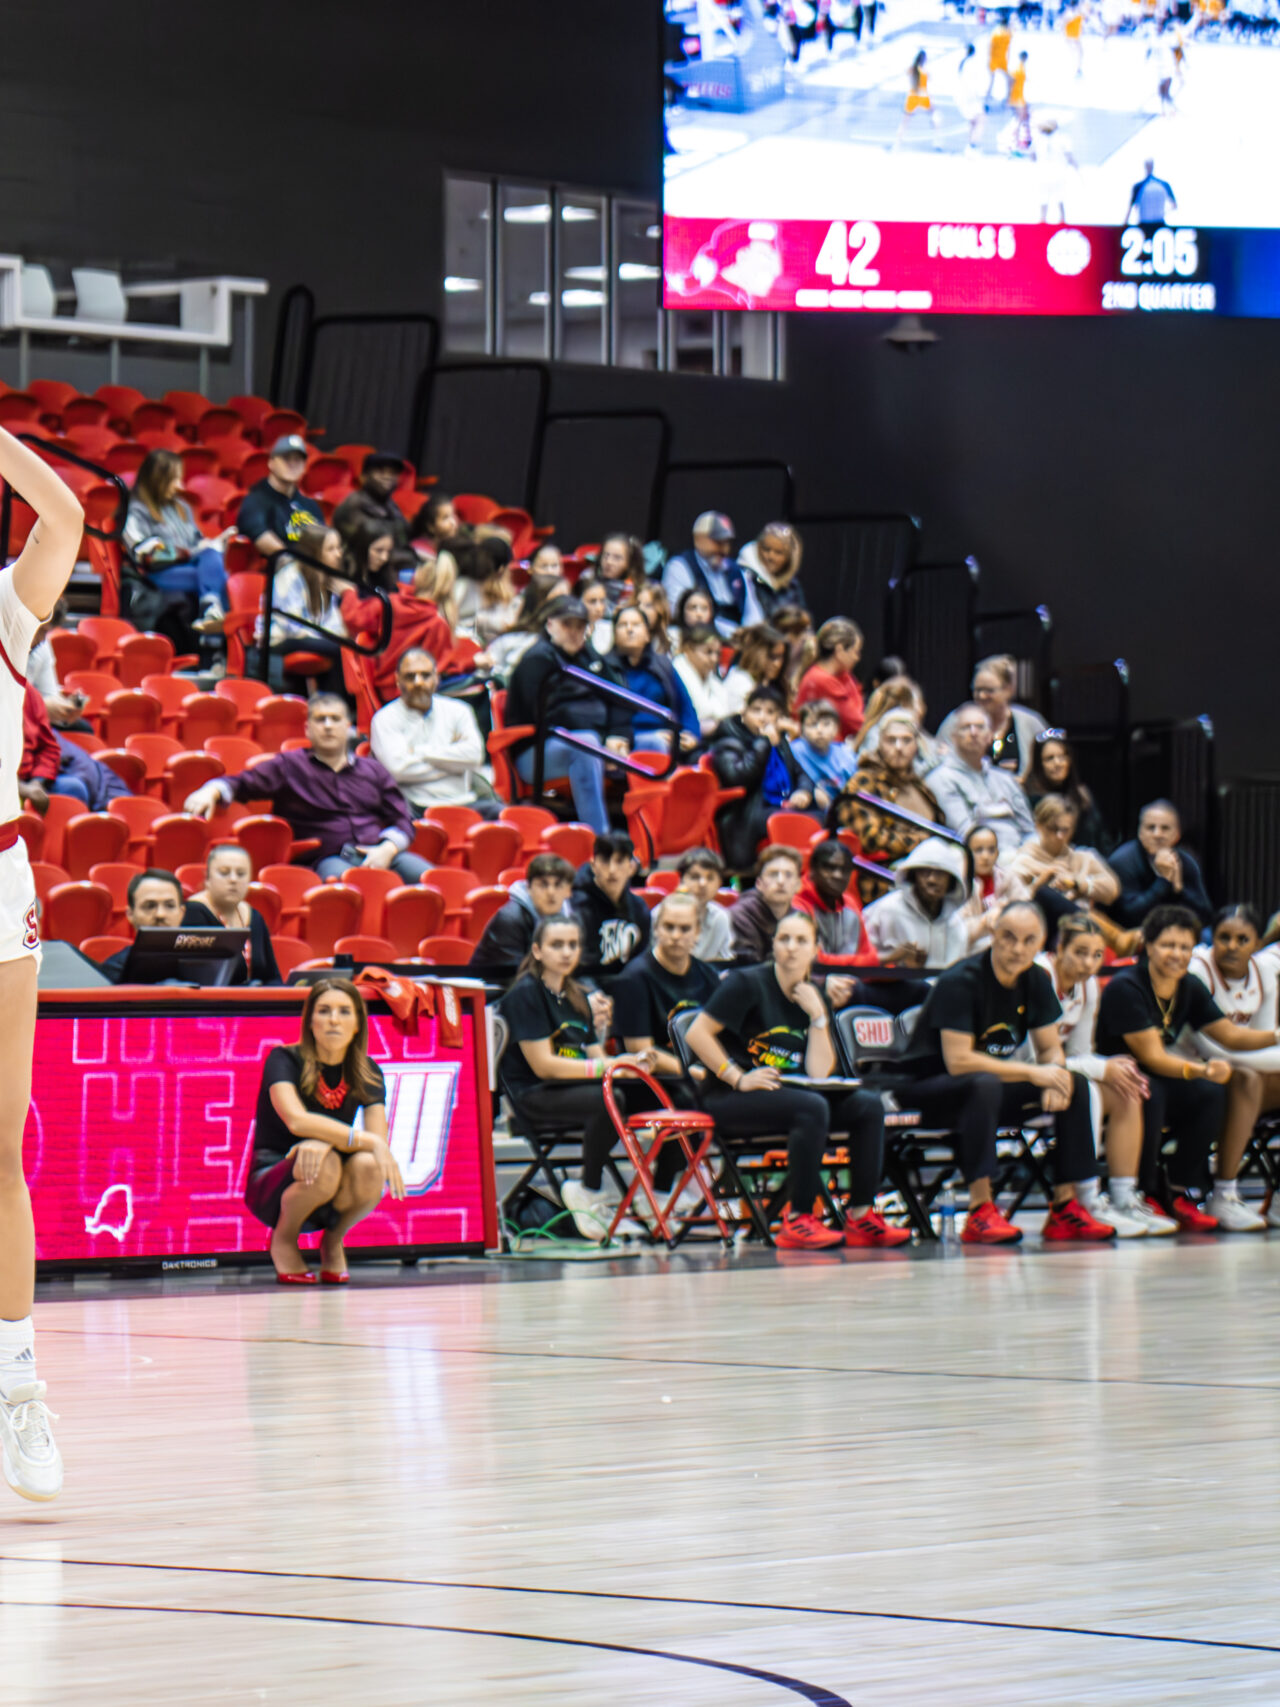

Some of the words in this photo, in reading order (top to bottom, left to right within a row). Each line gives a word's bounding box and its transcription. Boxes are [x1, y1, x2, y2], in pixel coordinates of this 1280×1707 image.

[815, 220, 882, 287] 42
[1121, 226, 1199, 277] 2:05
[1102, 281, 1138, 311] 2ND
[1138, 282, 1216, 312] QUARTER
[855, 1019, 891, 1045] SHU
[161, 1258, 218, 1271] DAKTRONICS
